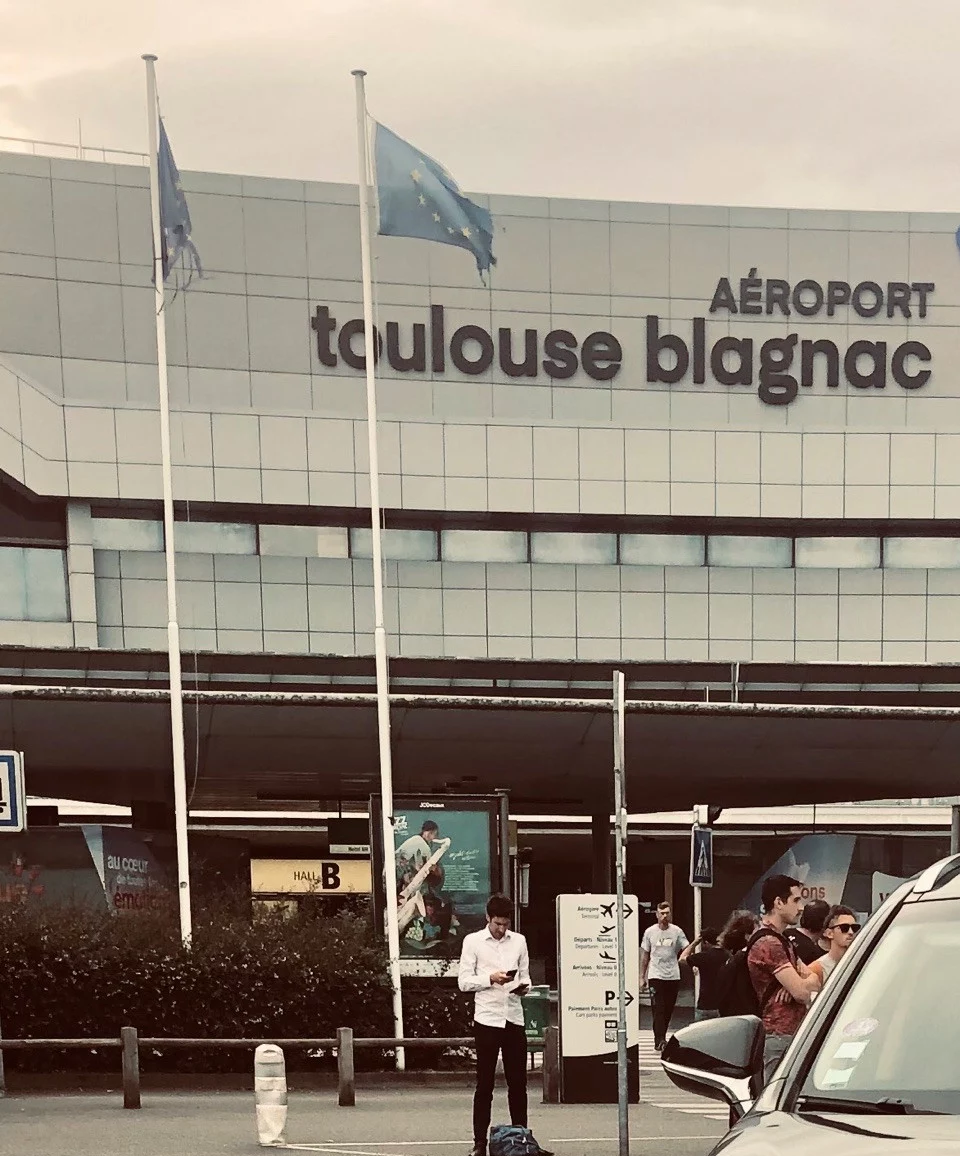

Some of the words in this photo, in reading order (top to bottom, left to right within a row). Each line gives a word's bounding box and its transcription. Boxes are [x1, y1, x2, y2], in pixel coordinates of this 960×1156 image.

[709, 268, 935, 318] AÉROPORT
[311, 304, 623, 382] toulouse
[646, 315, 932, 406] blagnac
[107, 855, 121, 870] au
[122, 857, 149, 873] cœur
[293, 871, 318, 881] HALL
[321, 862, 341, 889] B
[605, 990, 616, 1006] P
